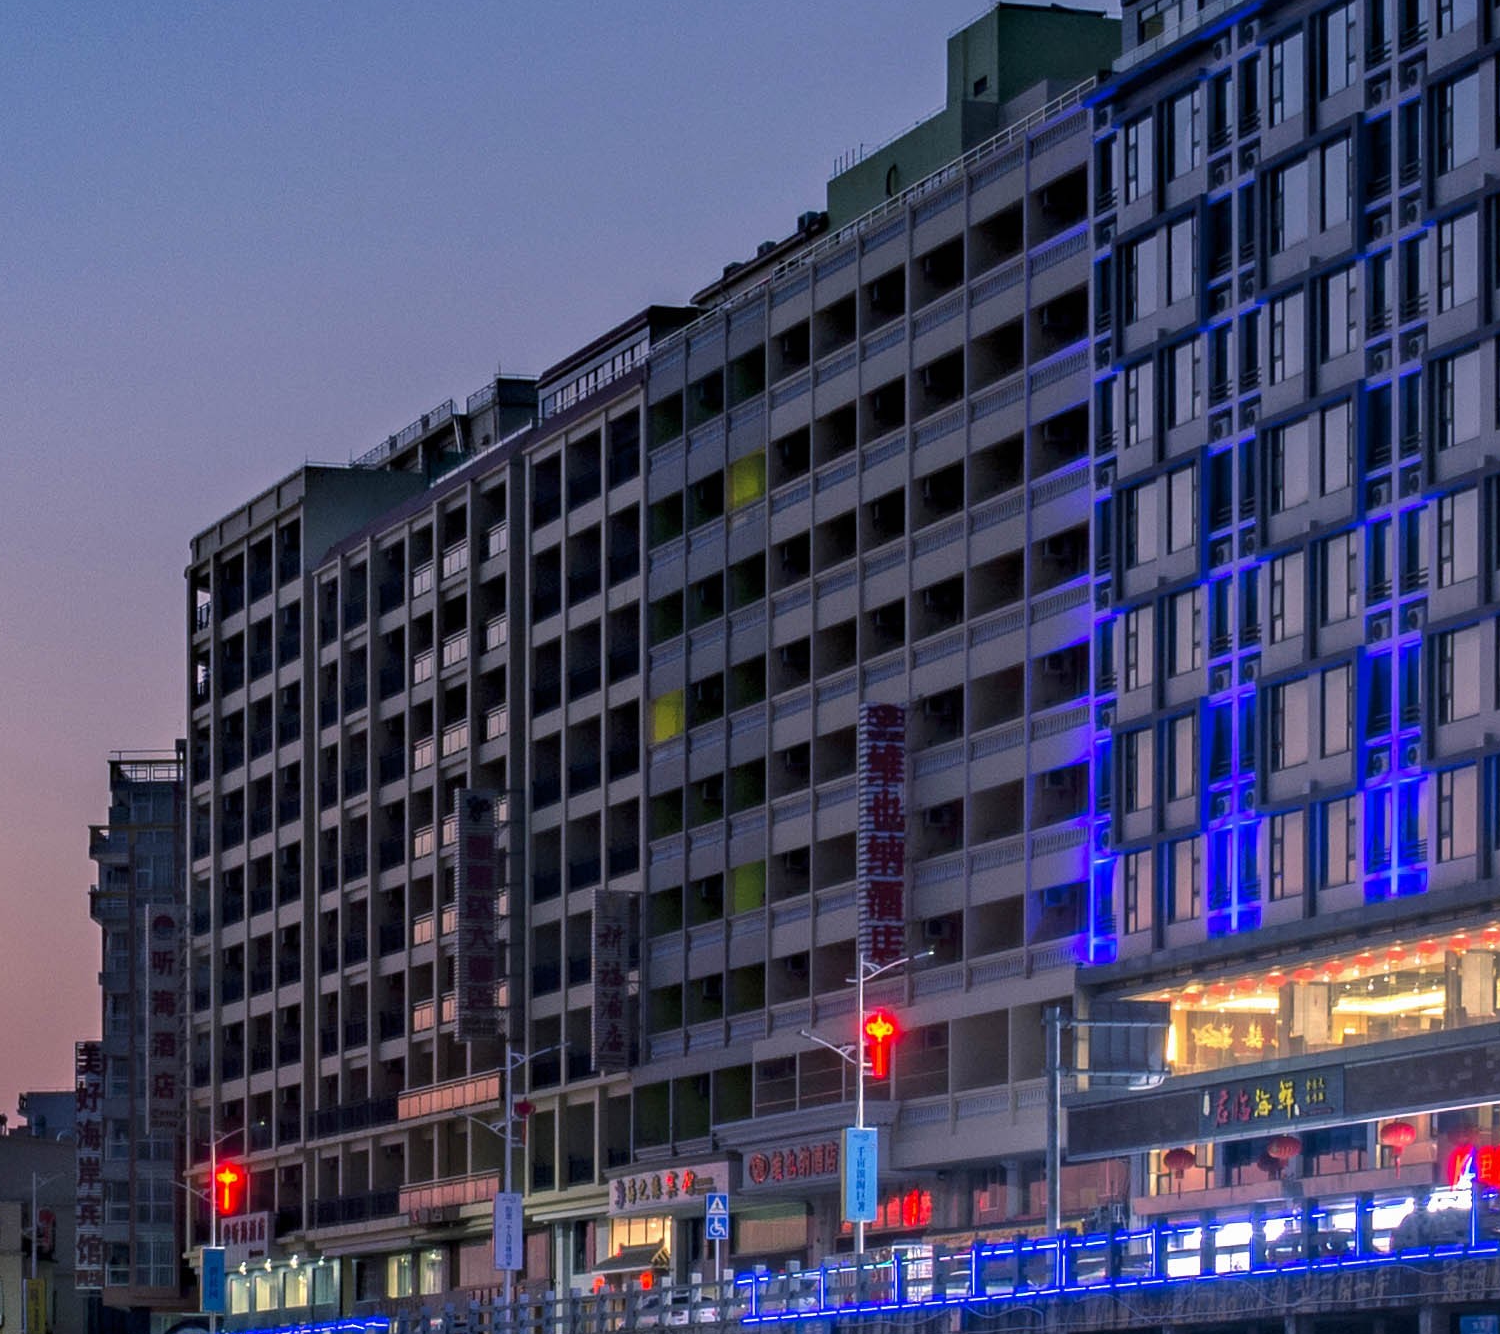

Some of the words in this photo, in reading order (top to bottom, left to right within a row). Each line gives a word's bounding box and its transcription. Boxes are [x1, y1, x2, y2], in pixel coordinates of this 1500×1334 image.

[152, 950, 176, 1099] 听海酒店
[77, 1043, 104, 1265] 美好海岸宾馆
